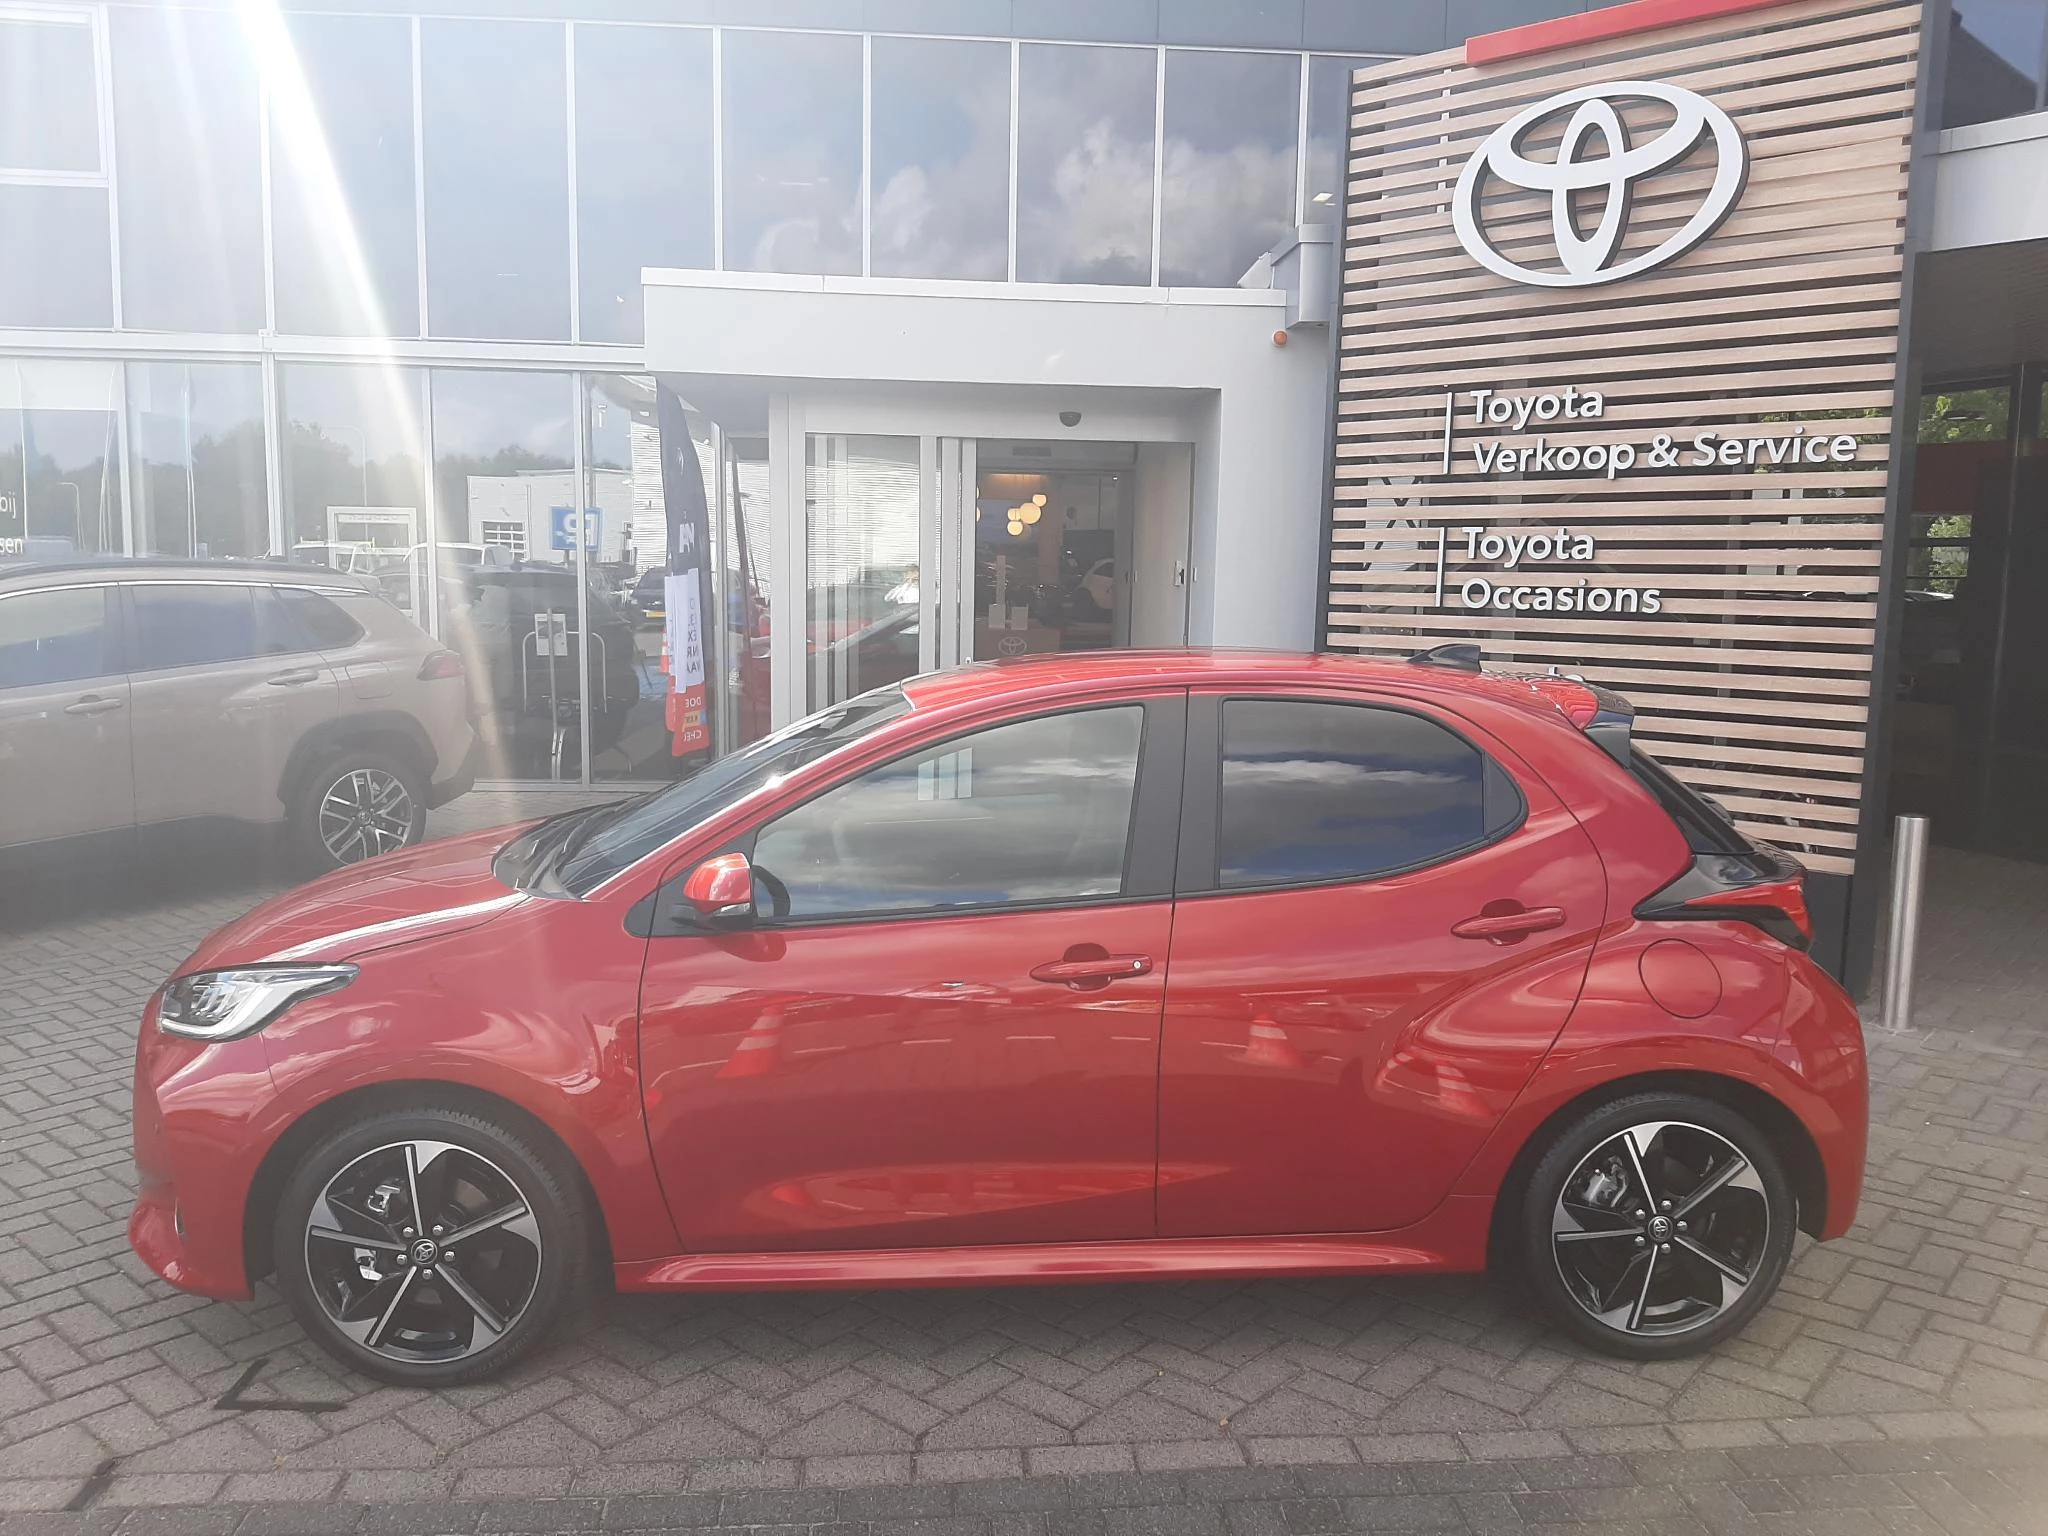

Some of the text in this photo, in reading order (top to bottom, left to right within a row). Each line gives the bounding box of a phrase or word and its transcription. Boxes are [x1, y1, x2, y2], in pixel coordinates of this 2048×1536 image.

[1470, 385, 1604, 432] Toyota
[1472, 426, 1858, 479] Verkoop & Service
[1461, 526, 1595, 568] Toyota
[1460, 577, 1662, 614] Occasions
